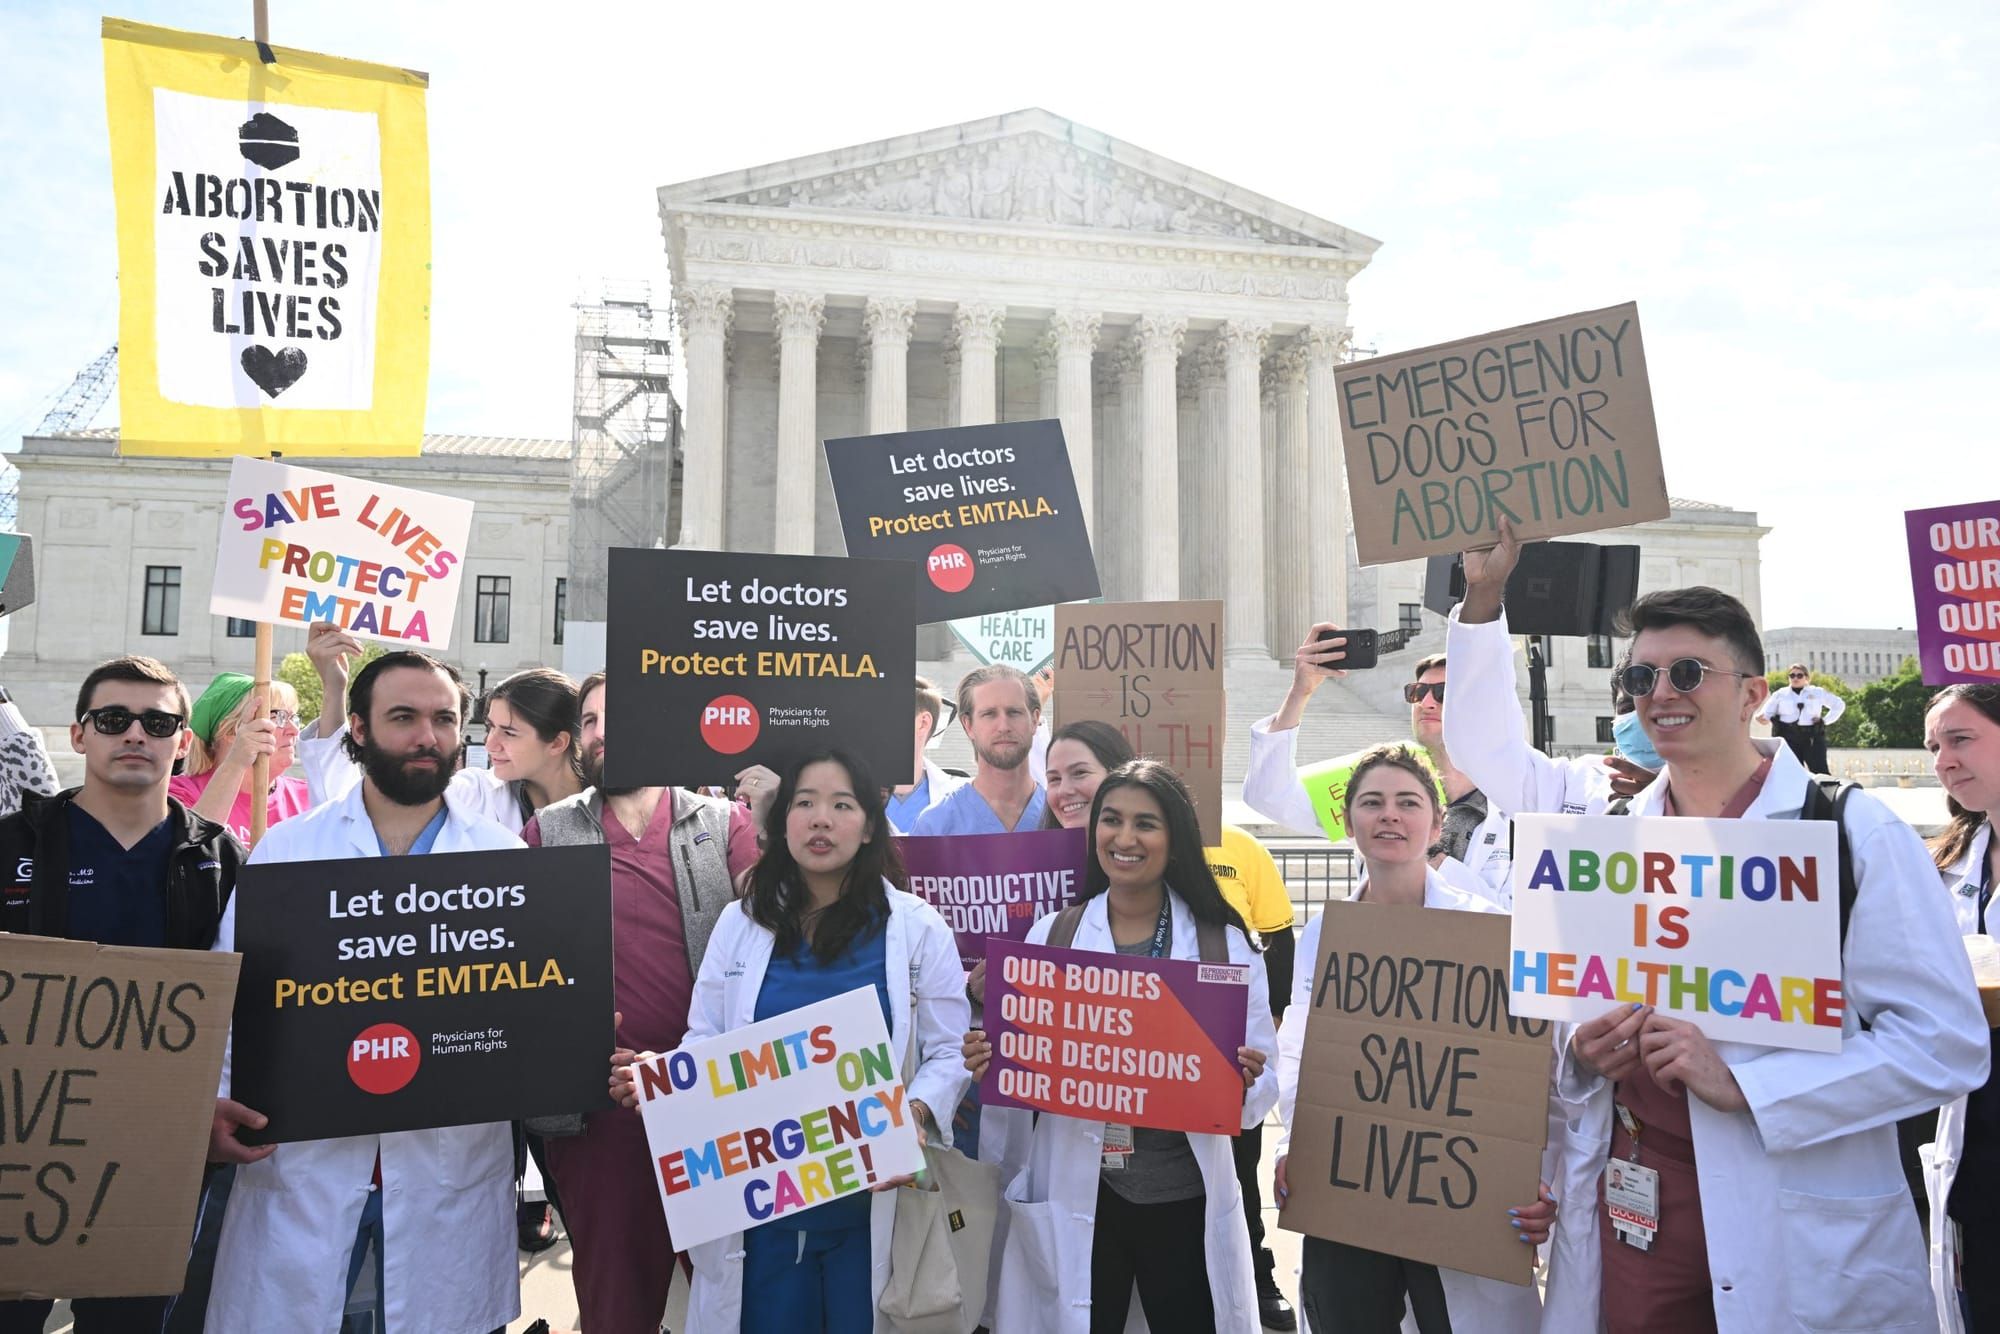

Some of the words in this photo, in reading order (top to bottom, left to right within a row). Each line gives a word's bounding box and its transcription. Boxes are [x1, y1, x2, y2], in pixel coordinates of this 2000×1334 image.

[162, 171, 380, 233] ABORTION
[198, 232, 349, 289] SAVES
[212, 288, 343, 341] LIVES
[1343, 319, 1630, 430] EMERGENCY
[1367, 412, 1497, 485] DOCS
[1515, 390, 1616, 457] FOR
[889, 452, 927, 475] Let
[932, 447, 1016, 471] doctors
[903, 482, 954, 503] save
[959, 475, 1016, 497] lives.
[1392, 450, 1630, 545] ABORTION
[234, 484, 340, 531] SAVE
[357, 494, 458, 580] LIVES
[868, 509, 954, 538] Protect
[958, 496, 1059, 527] EMTALA.
[1929, 517, 2000, 552] OUR
[259, 537, 428, 602] PROTECT
[928, 552, 967, 572] PHR
[977, 547, 1011, 557] Physicians
[1012, 545, 1022, 553] for
[980, 556, 1005, 565] Human
[1005, 553, 1027, 562] Rights
[686, 577, 731, 603] Let
[741, 578, 848, 607] doctors
[1934, 559, 2000, 593] OUR
[280, 586, 430, 642] EMTALA
[693, 619, 758, 640] save
[769, 615, 838, 642] lives.
[980, 616, 1045, 639] HEALTH
[641, 649, 748, 677] Protect
[758, 652, 885, 679] EMTALA.
[989, 640, 1033, 662] CARE
[1059, 622, 1216, 671] ABORTION
[705, 707, 751, 726] PHR
[769, 707, 812, 719] Physicians
[814, 707, 827, 716] for
[1119, 674, 1151, 718] IS
[769, 717, 801, 726] Human
[803, 717, 830, 728] Rights
[907, 869, 1076, 905] EPRODUCTIVE
[1528, 849, 1819, 902] ABORTION
[329, 890, 384, 919] Let
[395, 883, 526, 914] doctors
[1007, 903, 1033, 919] FOR
[338, 936, 417, 961] save
[429, 924, 515, 955] lives.
[1633, 903, 1690, 949] IS
[275, 972, 404, 1009] Protect
[416, 958, 575, 998] EMTALA.
[1002, 955, 1056, 990] OUR
[1065, 964, 1161, 1001] BODIES
[1512, 950, 1846, 1028] HEALTHCARE
[432, 1030, 485, 1044] Physicians
[487, 1027, 504, 1038] for
[1001, 993, 1054, 1027] OUR
[1063, 1001, 1133, 1037] LIVES
[352, 1036, 410, 1062] PHR
[432, 1043, 472, 1055] Human
[474, 1039, 508, 1053] Rights
[639, 1052, 697, 1102] NO
[706, 1025, 837, 1099] LIMITS
[836, 1042, 894, 1092] ON
[1000, 1030, 1053, 1065] OUR
[1062, 1040, 1201, 1082] DECISIONS
[998, 1068, 1051, 1101] OUR
[1060, 1077, 1148, 1115] COURT
[1354, 1033, 1480, 1117] SAVE
[658, 1084, 904, 1196] EMERGENCY
[743, 1143, 877, 1221] CARE!
[1330, 1115, 1479, 1210] LIVES
